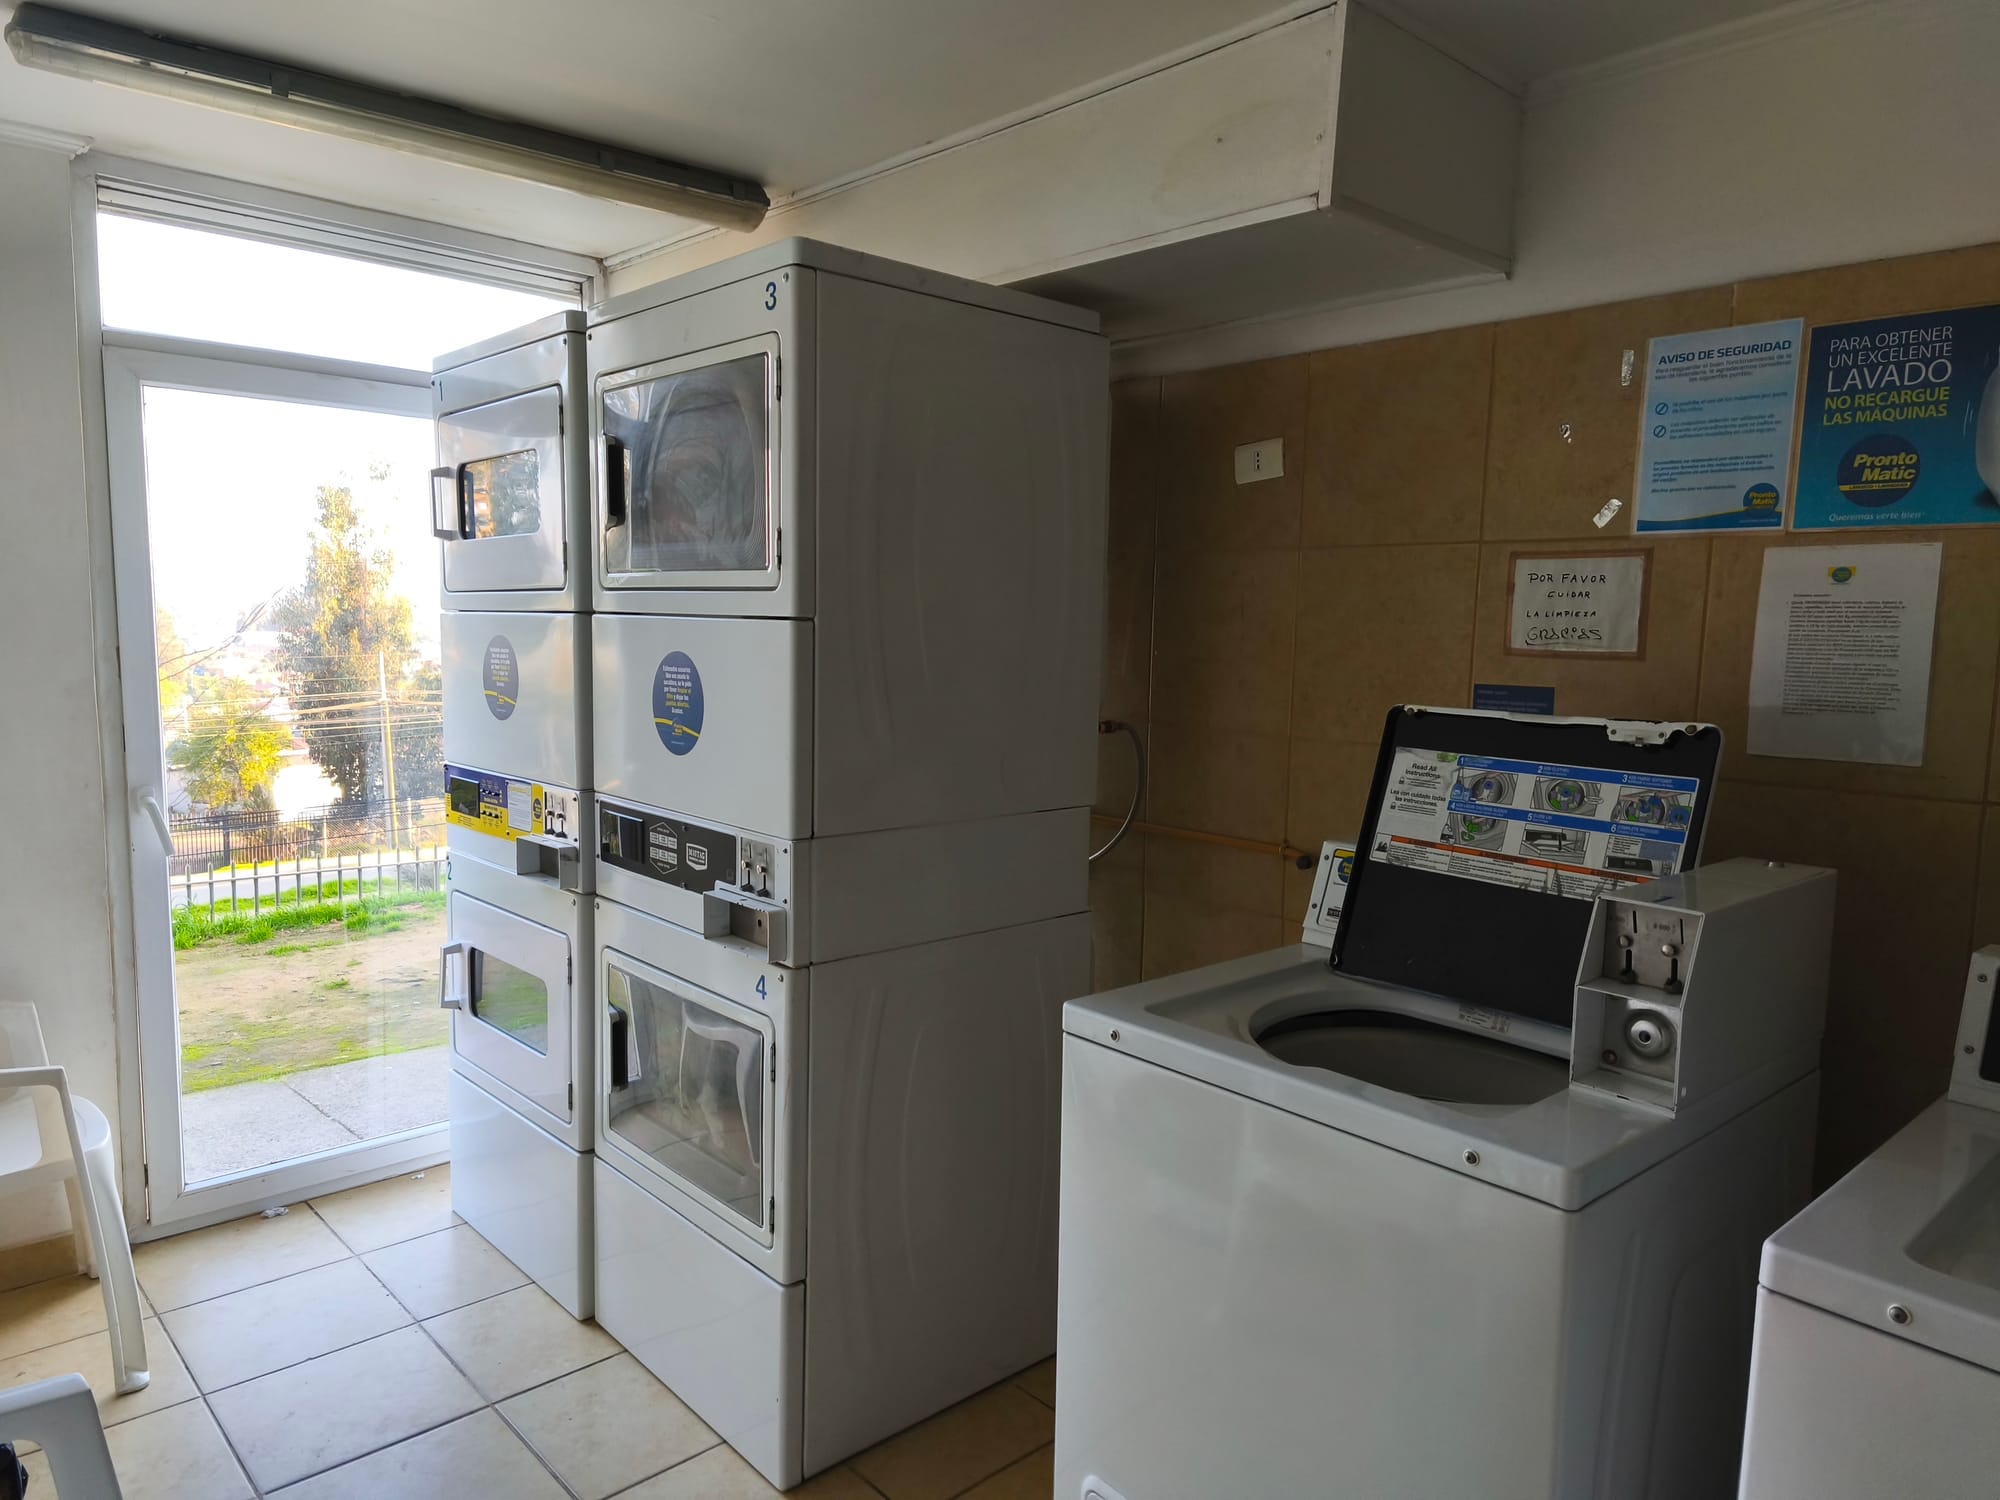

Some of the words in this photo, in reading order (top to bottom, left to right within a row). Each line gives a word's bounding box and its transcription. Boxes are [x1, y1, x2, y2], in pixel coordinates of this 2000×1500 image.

[765, 281, 777, 311] 3
[1830, 335, 1871, 353] PARA
[1875, 325, 1953, 348] OBTENER
[1658, 352, 1695, 365] AVISO
[1698, 349, 1714, 360] DE
[1716, 340, 1792, 358] SEGURIDAD
[1828, 354, 1853, 369] UN
[1857, 341, 1953, 366] EXCELENTE
[1827, 358, 1953, 393] LAVADO
[1824, 395, 1851, 410] NO
[1854, 386, 1950, 408] RECARGUE
[1823, 411, 1852, 426] LAS
[1853, 451, 1918, 468] Pronto
[1861, 466, 1917, 482] Matic
[1527, 572, 1554, 584] POR
[1561, 572, 1607, 584] FAVOR
[1547, 590, 1591, 599] CUIDAR
[1526, 610, 1539, 618] LA
[1545, 610, 1597, 618] LIMPIEZA
[1412, 762, 1428, 771] Read
[1610, 824, 1617, 832] 6
[447, 861, 452, 881] 2
[755, 974, 768, 1001] 4
